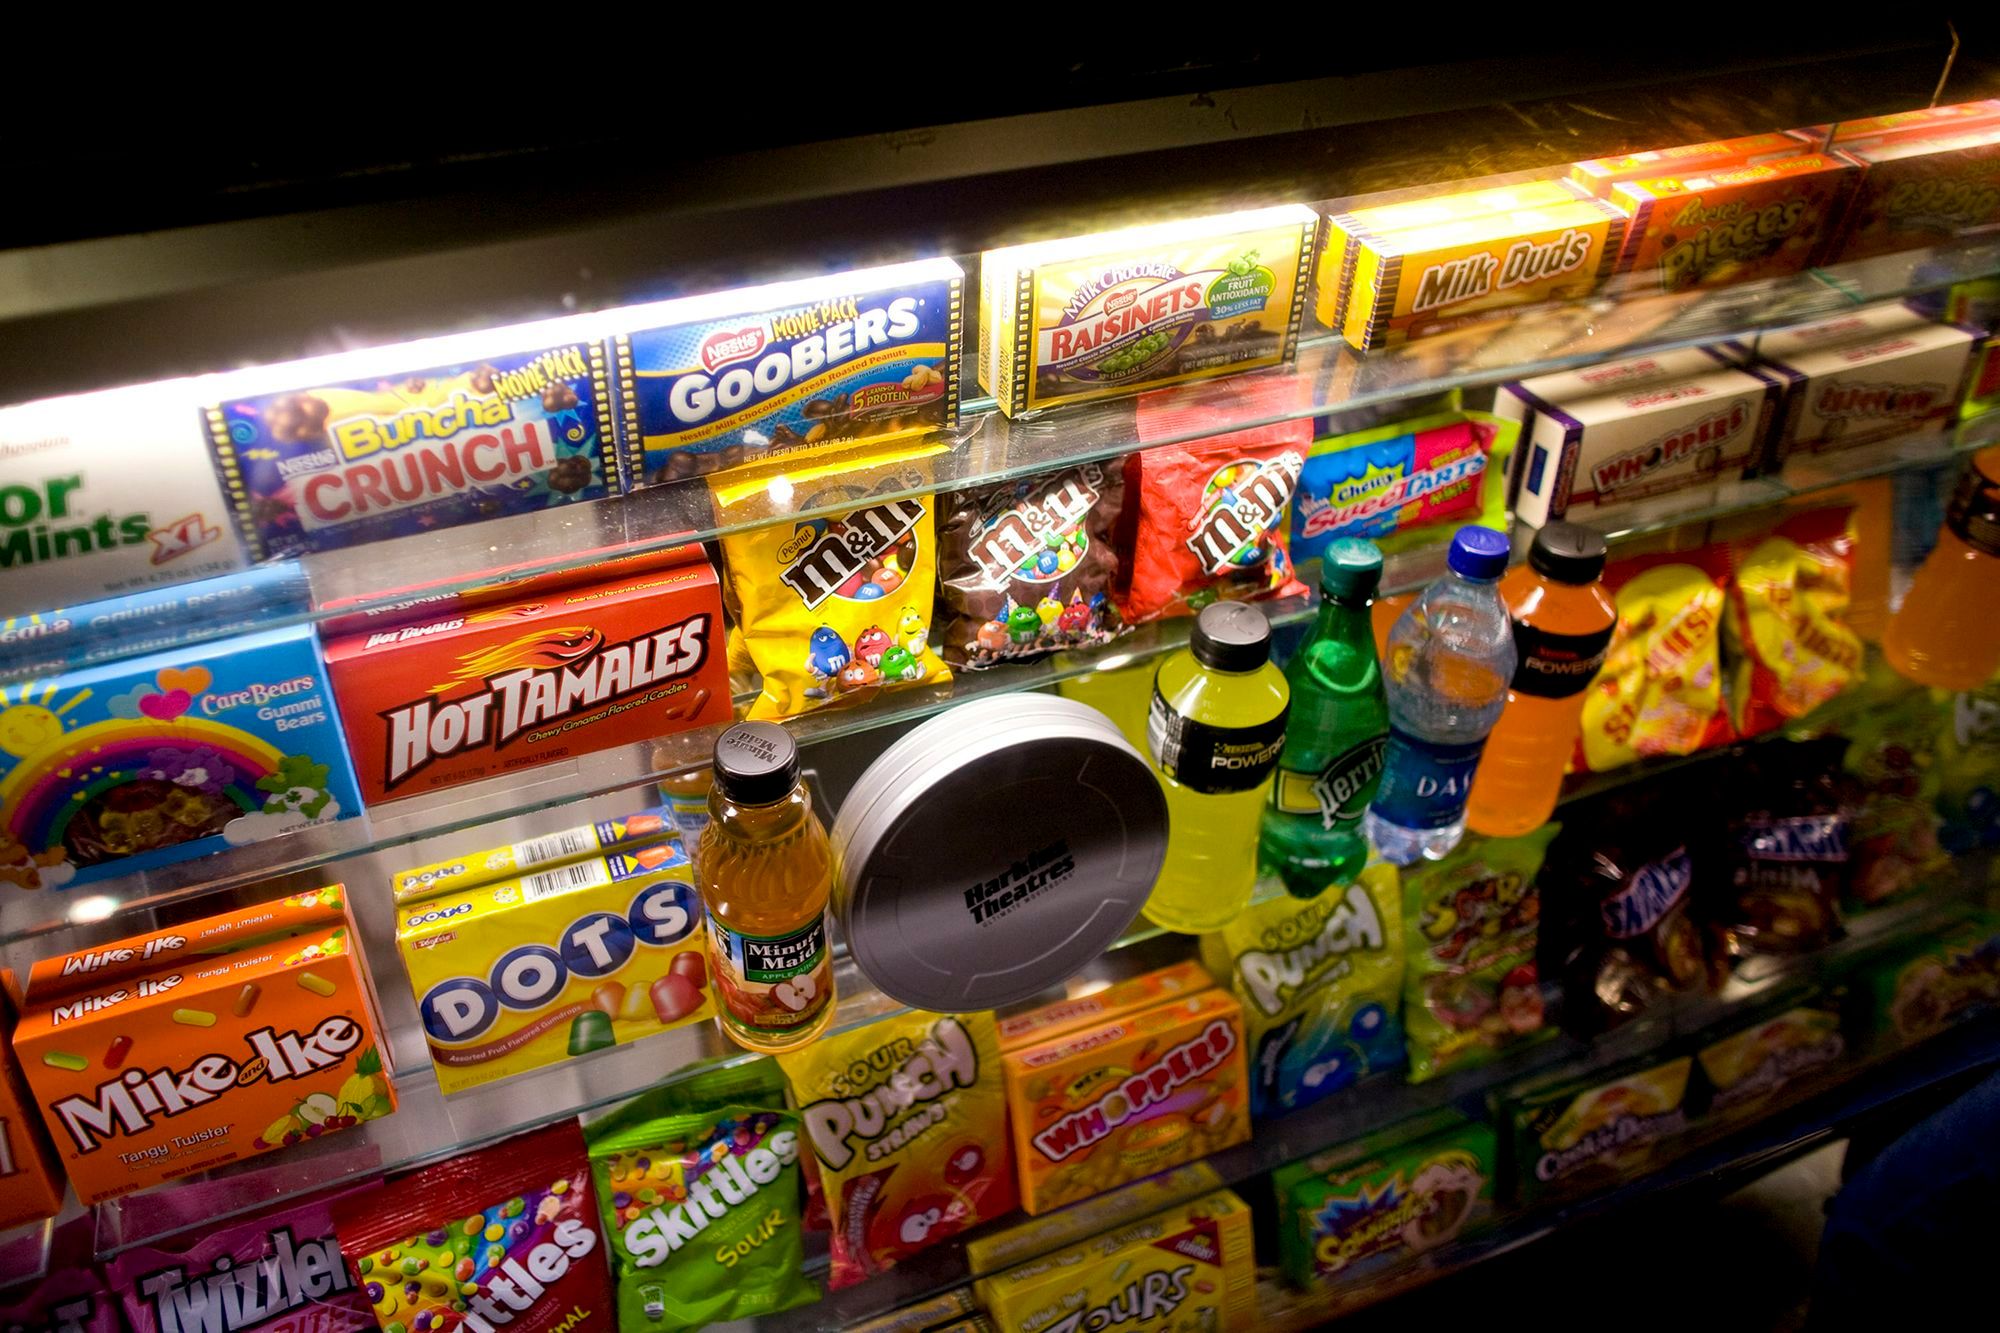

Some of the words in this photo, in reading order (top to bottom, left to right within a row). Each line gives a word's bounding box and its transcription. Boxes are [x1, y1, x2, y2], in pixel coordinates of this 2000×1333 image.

[1063, 281, 1101, 320] Milk
[1100, 262, 1178, 288] Chocolate
[1210, 284, 1269, 303] ANTIOXIDANTS
[1228, 279, 1254, 291] FRUIT
[1412, 252, 1498, 313] Milk
[1497, 229, 1592, 289] Duds
[772, 305, 822, 340] MOVIE
[820, 300, 860, 327] PACK
[1050, 282, 1203, 363] RAISINETS
[492, 361, 547, 402] MOVIE
[545, 346, 589, 378] PACK
[670, 297, 920, 423] GOOBERS
[714, 418, 738, 434] Milk
[738, 395, 788, 424] Chocolate
[799, 377, 827, 394] Fresh
[827, 360, 868, 381] Roasted
[868, 348, 908, 365] Peanuts
[853, 390, 866, 412] 5
[866, 391, 912, 407] PROTEIN
[334, 391, 513, 462] Buncha
[744, 453, 758, 463] NET
[772, 446, 790, 458] PESO
[790, 443, 810, 455] NETO
[1592, 400, 1750, 494] WHOPPERS
[303, 422, 546, 523] CRUNCH
[1337, 472, 1397, 503] Chewy
[149, 512, 223, 566] XL
[781, 529, 812, 556] Peanut
[565, 591, 603, 606] America's
[603, 584, 636, 598] Favorite
[635, 577, 674, 592] Cinnamon
[673, 572, 699, 584] Candy
[365, 629, 398, 649] HOT
[396, 617, 465, 641] TAMALES
[257, 694, 323, 722] Gummi
[275, 710, 327, 733] Bears
[386, 692, 492, 782] HOT
[490, 617, 706, 742] TAMALES
[527, 726, 562, 744] Chewy
[562, 710, 607, 733] Cinnamon
[606, 694, 649, 719] Flavored
[648, 681, 689, 702] Candies
[540, 746, 570, 760] FLAVORED
[737, 730, 778, 750] Maid
[406, 902, 474, 927] DOTS
[969, 853, 1075, 925] Theatres
[194, 965, 231, 981] Tangy
[232, 951, 275, 970] Twister
[427, 884, 695, 1040] DOTS
[747, 923, 822, 957] Minute
[761, 939, 818, 970] Maid
[1236, 884, 1386, 1022] PUNCH
[761, 970, 796, 981] APPLE
[795, 957, 819, 977] JUICE
[52, 987, 130, 1027] Mike
[136, 973, 185, 1000] Ike
[245, 1015, 364, 1084] Ike
[448, 1050, 487, 1064] Assorted
[487, 1043, 508, 1058] Fruit
[507, 1026, 542, 1050] Flavored
[540, 1003, 583, 1030] Gumdrops
[239, 1060, 268, 1084] and
[831, 1036, 915, 1095] SOUR
[1031, 1019, 1238, 1164] WHOPPERS
[51, 1053, 239, 1156] Mike
[801, 1016, 980, 1173] PUNCH
[118, 1141, 170, 1166] Tangy
[170, 1122, 231, 1149] Twister
[624, 1130, 800, 1269] Skittles
[715, 1208, 787, 1270] SOUR
